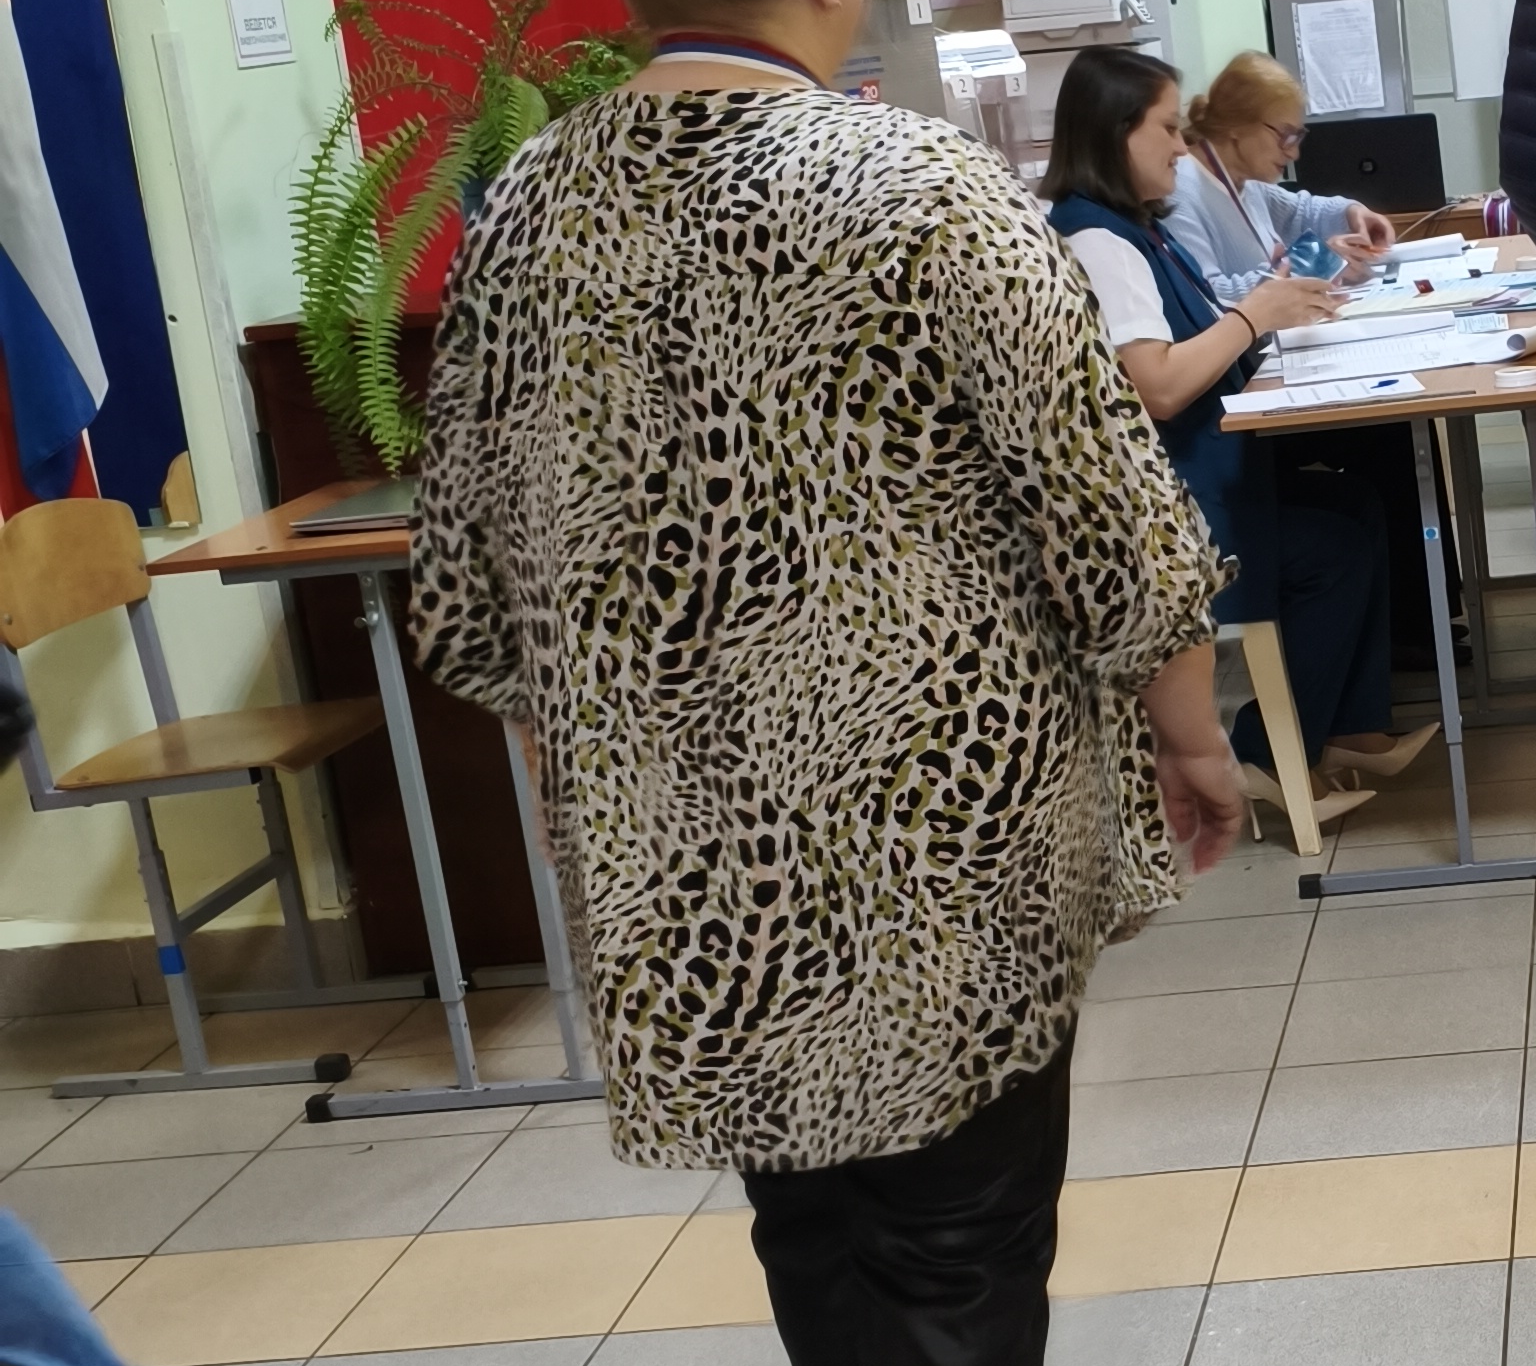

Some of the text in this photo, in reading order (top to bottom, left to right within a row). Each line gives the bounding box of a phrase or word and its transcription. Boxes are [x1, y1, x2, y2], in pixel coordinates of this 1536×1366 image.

[916, 2, 923, 19] 1
[243, 16, 278, 32] ВЕДЕТСЯ
[959, 78, 968, 93] 2
[1013, 77, 1021, 92] 3
